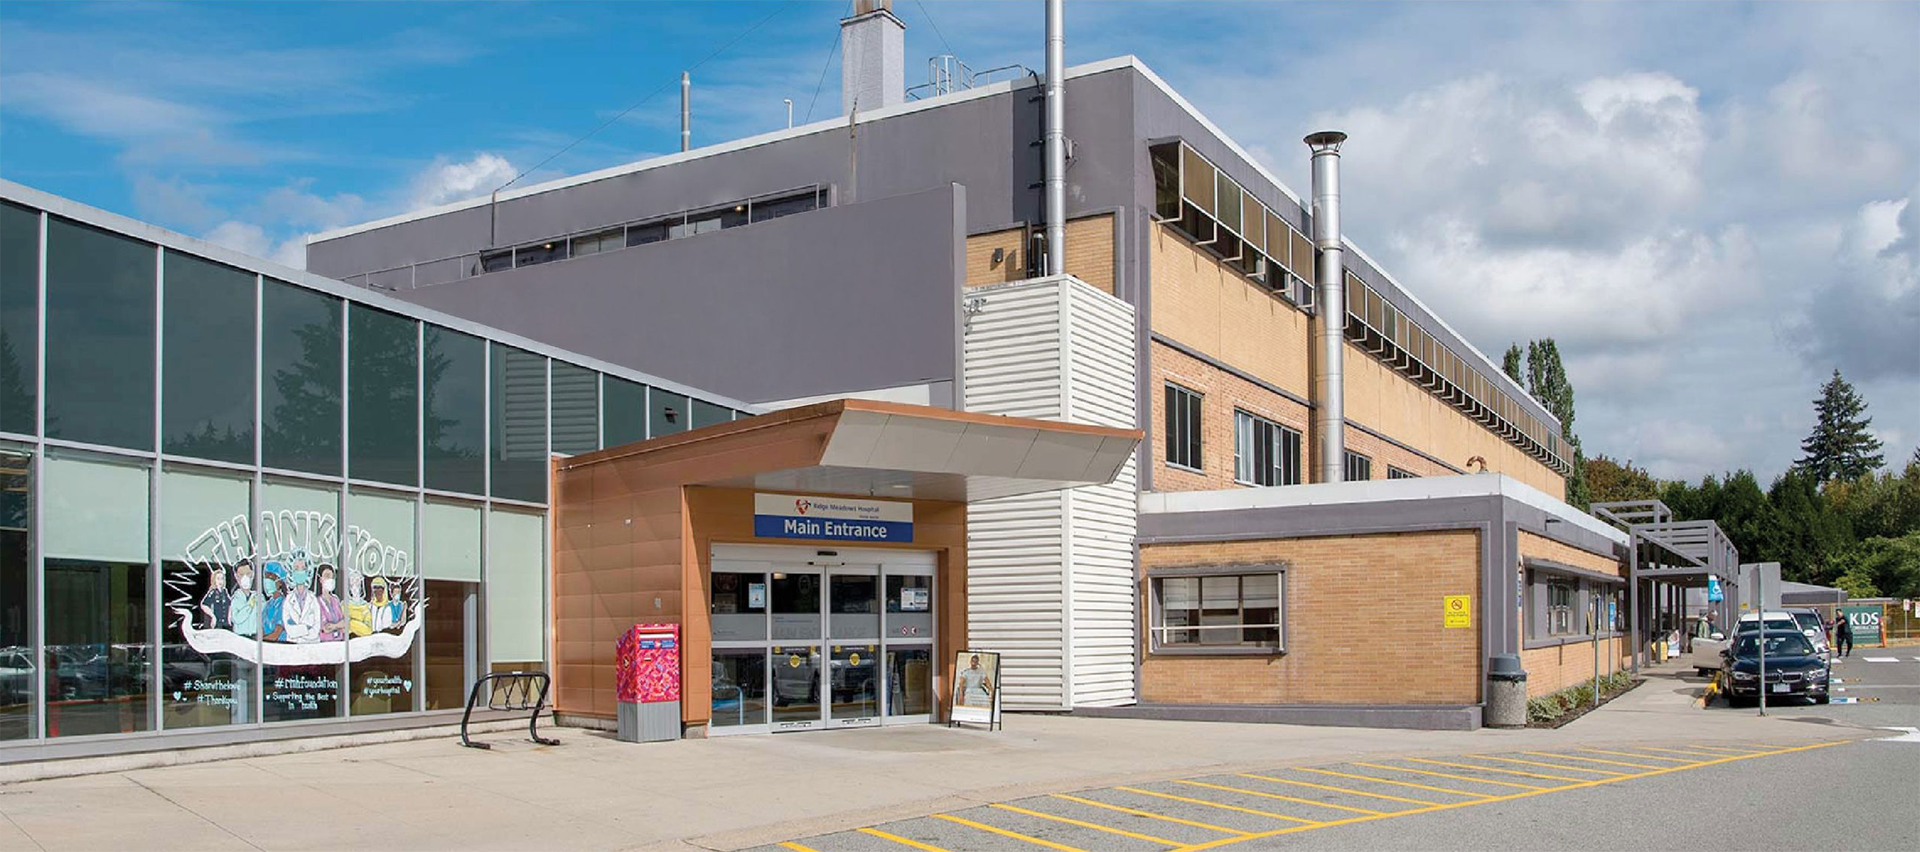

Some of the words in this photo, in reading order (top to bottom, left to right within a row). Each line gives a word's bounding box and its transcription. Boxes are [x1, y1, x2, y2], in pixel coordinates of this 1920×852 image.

[829, 504, 857, 512] Meadows
[784, 519, 820, 535] Main
[825, 521, 888, 539] Entrance
[186, 509, 336, 574] THANK
[346, 524, 408, 584] YOU
[1849, 612, 1879, 626] KDS
